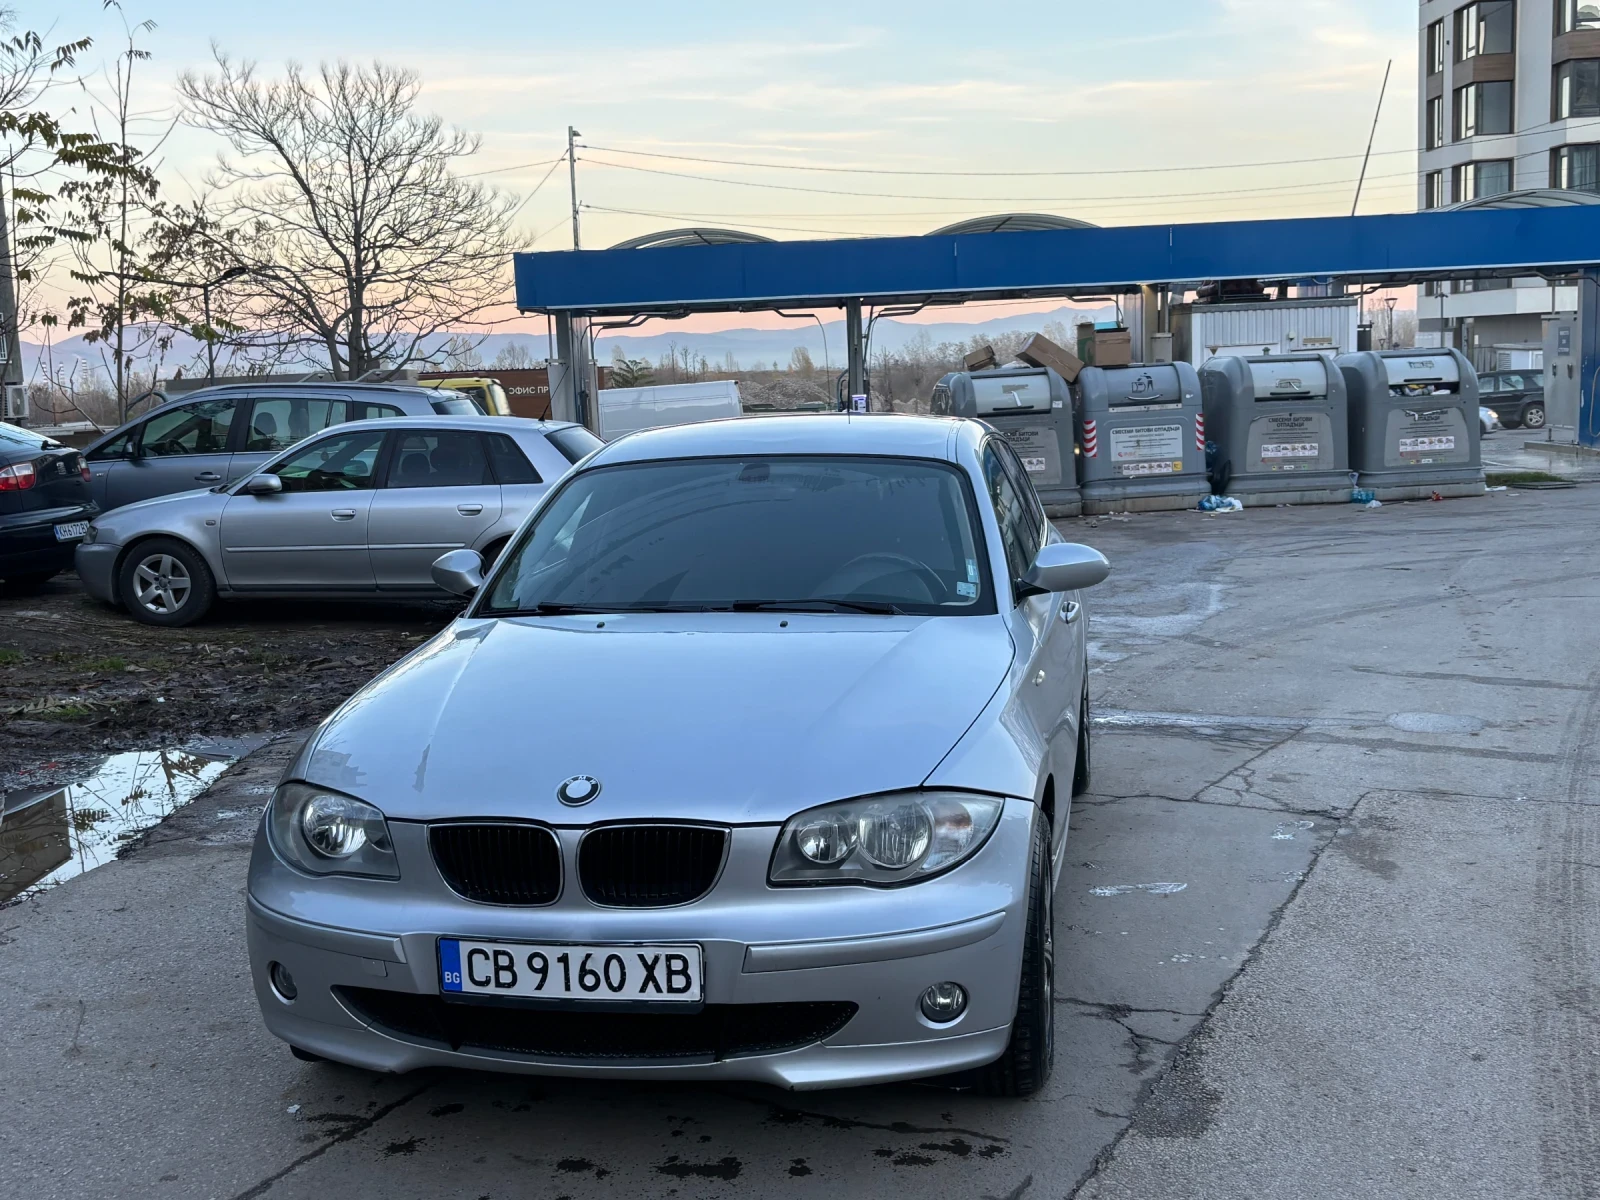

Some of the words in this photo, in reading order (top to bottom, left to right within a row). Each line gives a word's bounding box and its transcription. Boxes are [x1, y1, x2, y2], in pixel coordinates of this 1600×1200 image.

[444, 971, 461, 984] BG
[467, 948, 518, 989] CB
[527, 951, 627, 993] 9160
[638, 952, 692, 994] XB
